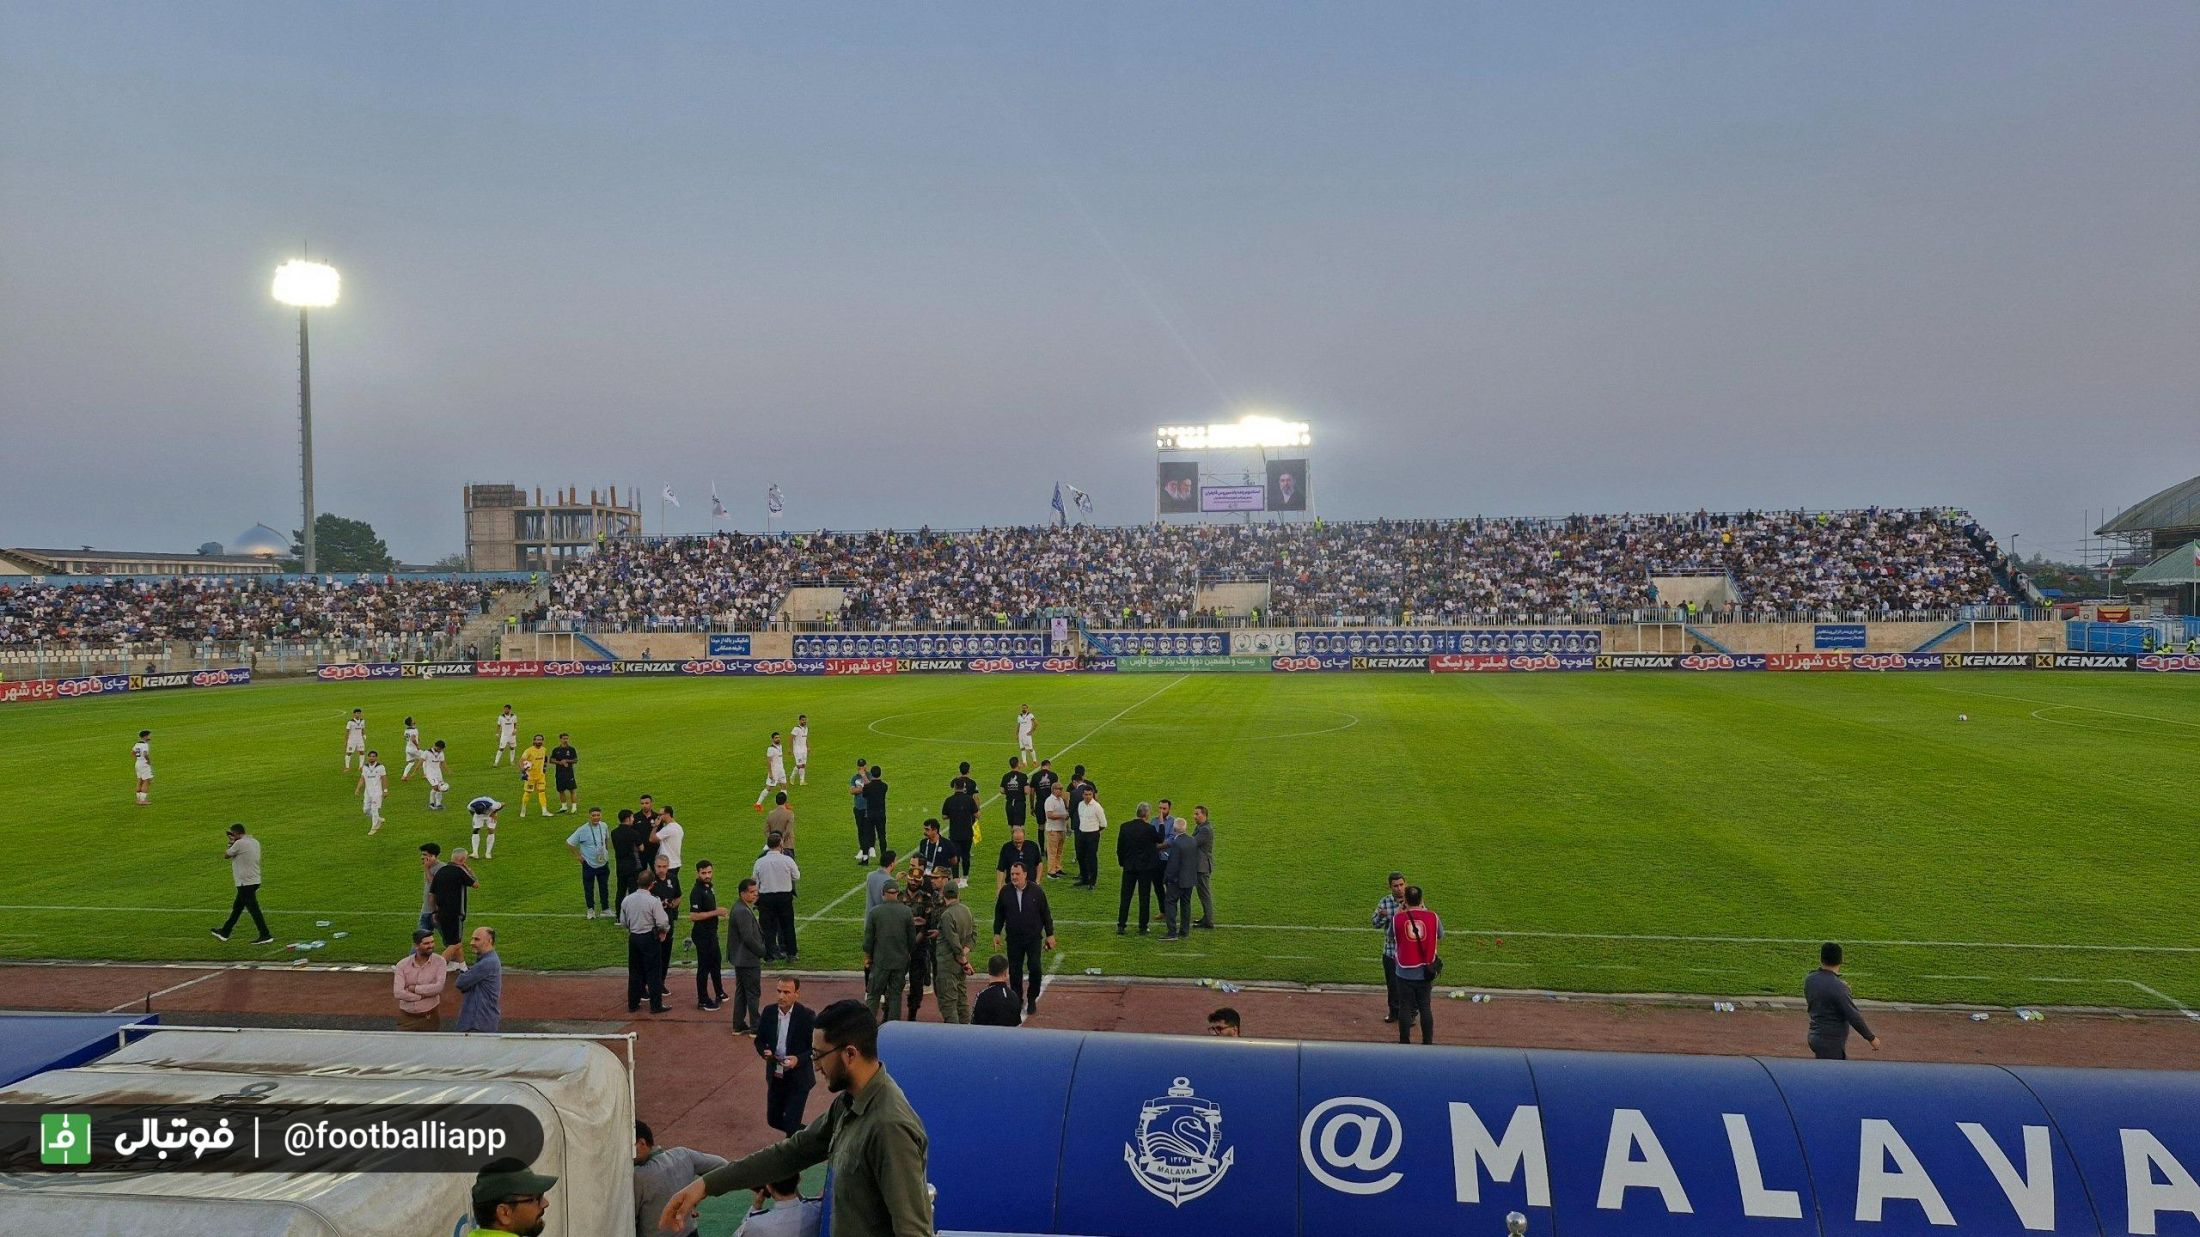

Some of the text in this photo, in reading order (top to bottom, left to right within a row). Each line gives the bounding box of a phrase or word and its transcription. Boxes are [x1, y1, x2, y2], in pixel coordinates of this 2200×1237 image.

[727, 660, 752, 672] چای
[872, 659, 893, 673] چای
[911, 659, 963, 670] KENZAX
[1015, 659, 1041, 670] چای
[1322, 657, 1350, 670] چای
[1368, 658, 1427, 668] KENZAX
[1612, 658, 1675, 668] KENZAX
[1735, 656, 1766, 668] چای
[1826, 653, 1851, 670] چای
[1962, 655, 2028, 666] KENZAX
[2055, 656, 2128, 668] KENZAX
[371, 665, 399, 676] چای
[417, 664, 472, 676] KENZAX
[626, 663, 677, 672] KENZAX
[104, 678, 128, 690] چای
[142, 675, 189, 687] KENZAX
[1157, 1166, 1197, 1175] MALAVAN
